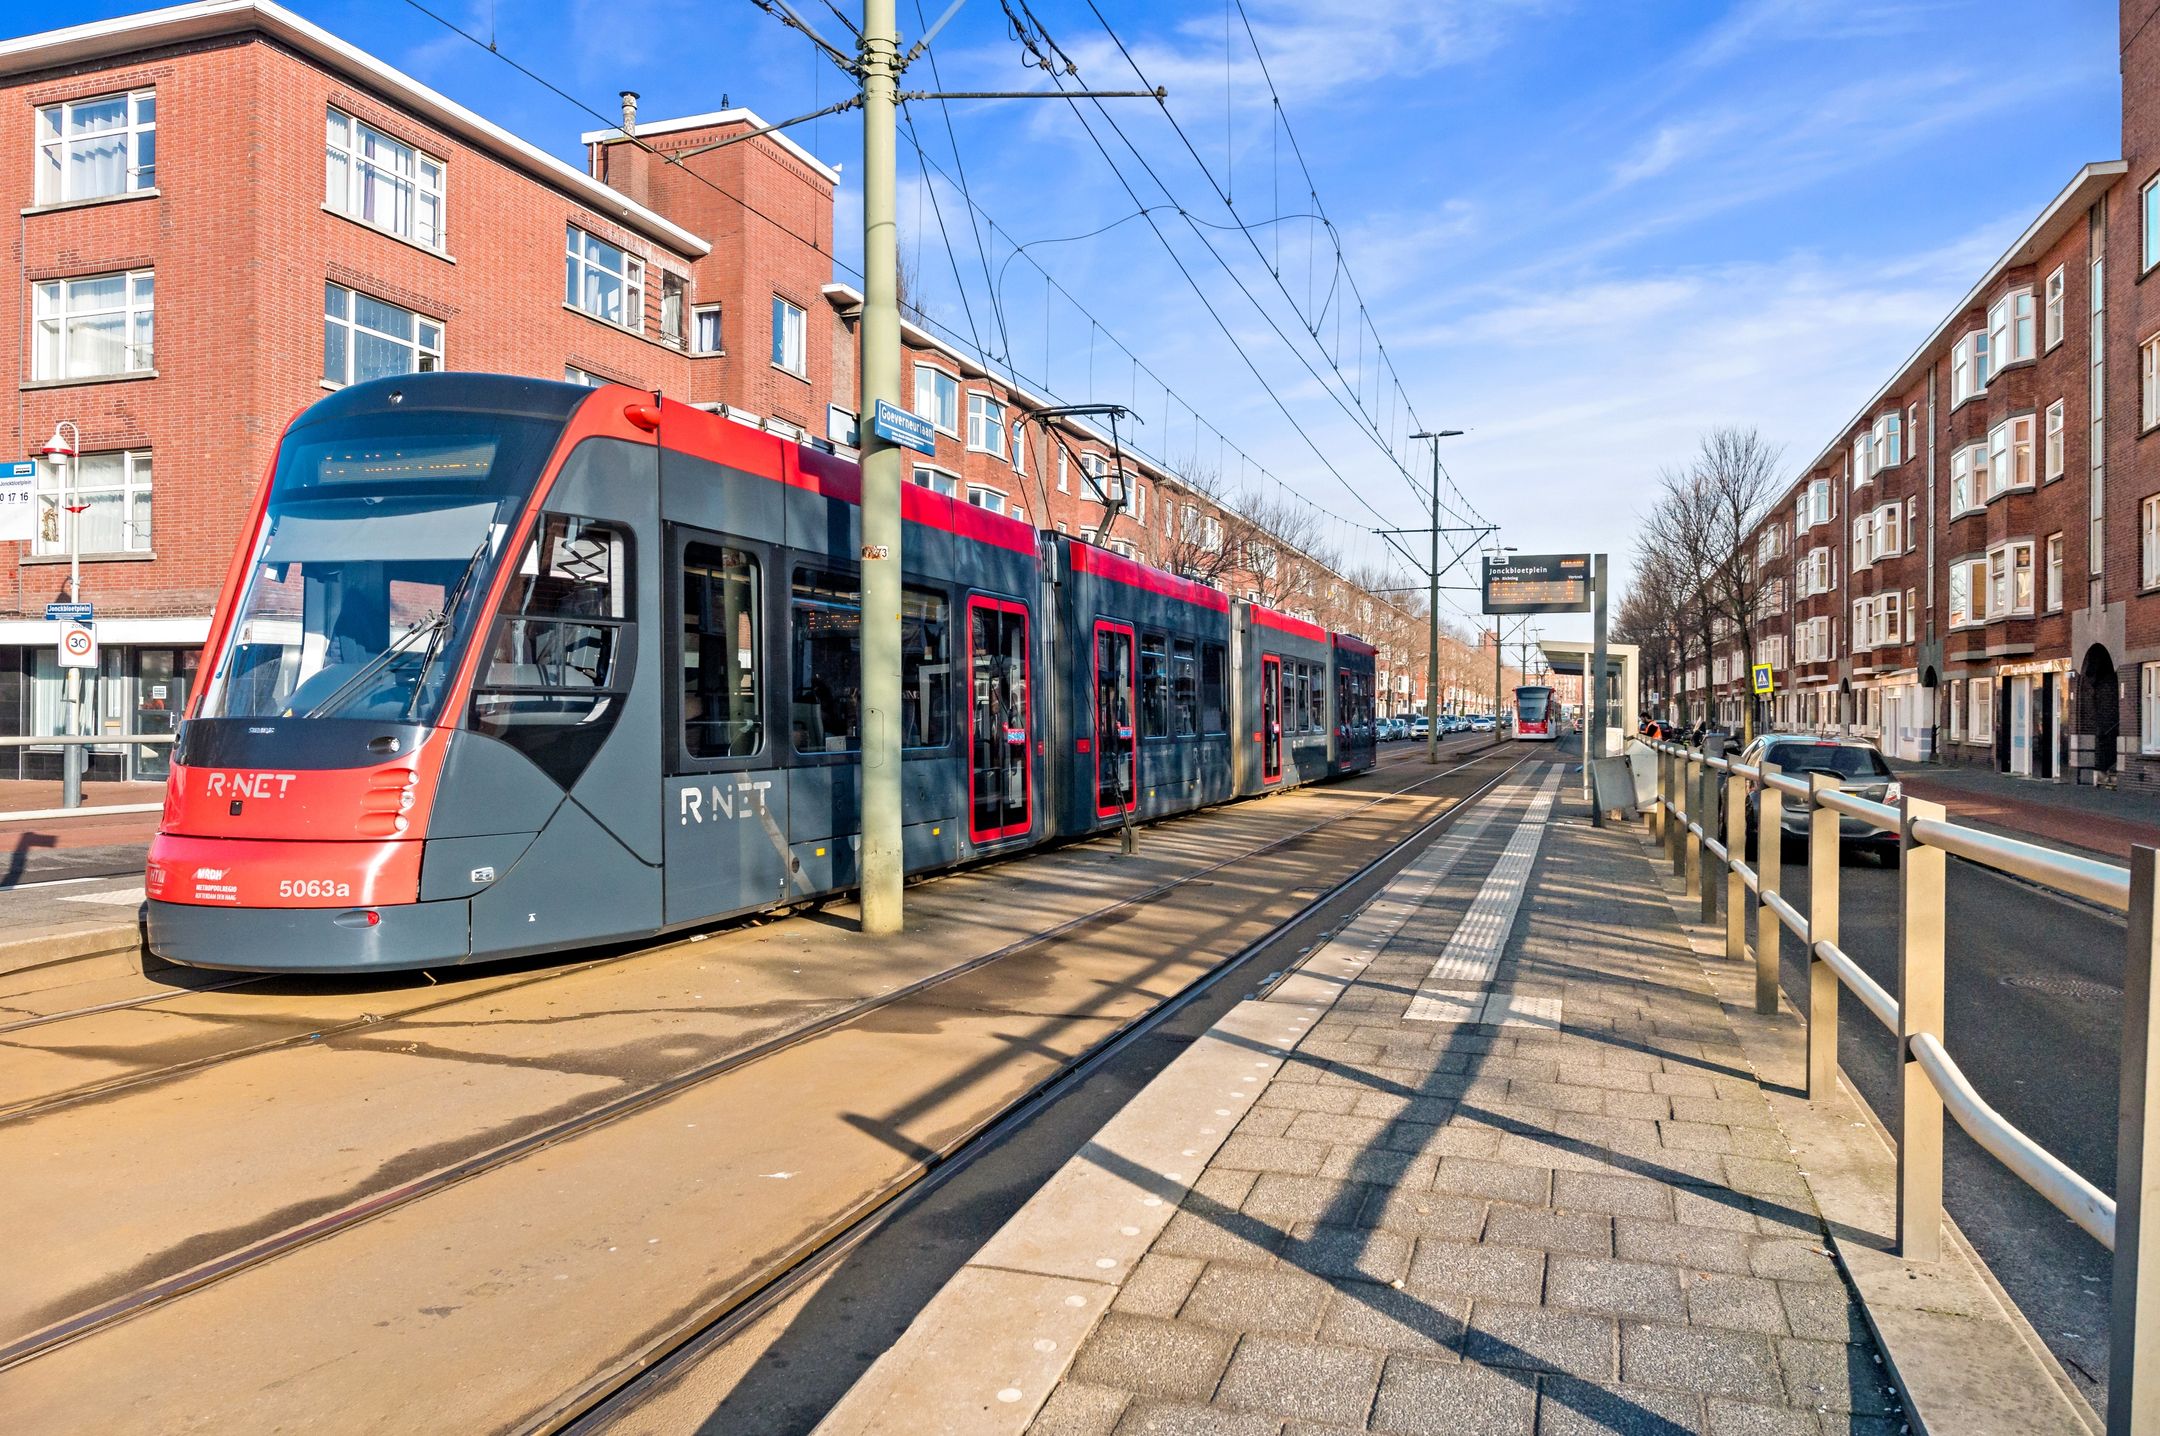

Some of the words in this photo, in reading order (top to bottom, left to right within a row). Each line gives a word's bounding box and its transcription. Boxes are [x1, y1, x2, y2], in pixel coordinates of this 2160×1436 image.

[881, 406, 933, 439] Goeverneurlaan
[8, 493, 16, 502] 17
[20, 492, 28, 500] 16
[1489, 566, 1548, 575] Jonckbloetplein
[70, 637, 87, 649] 30
[279, 879, 350, 897] 5063a
